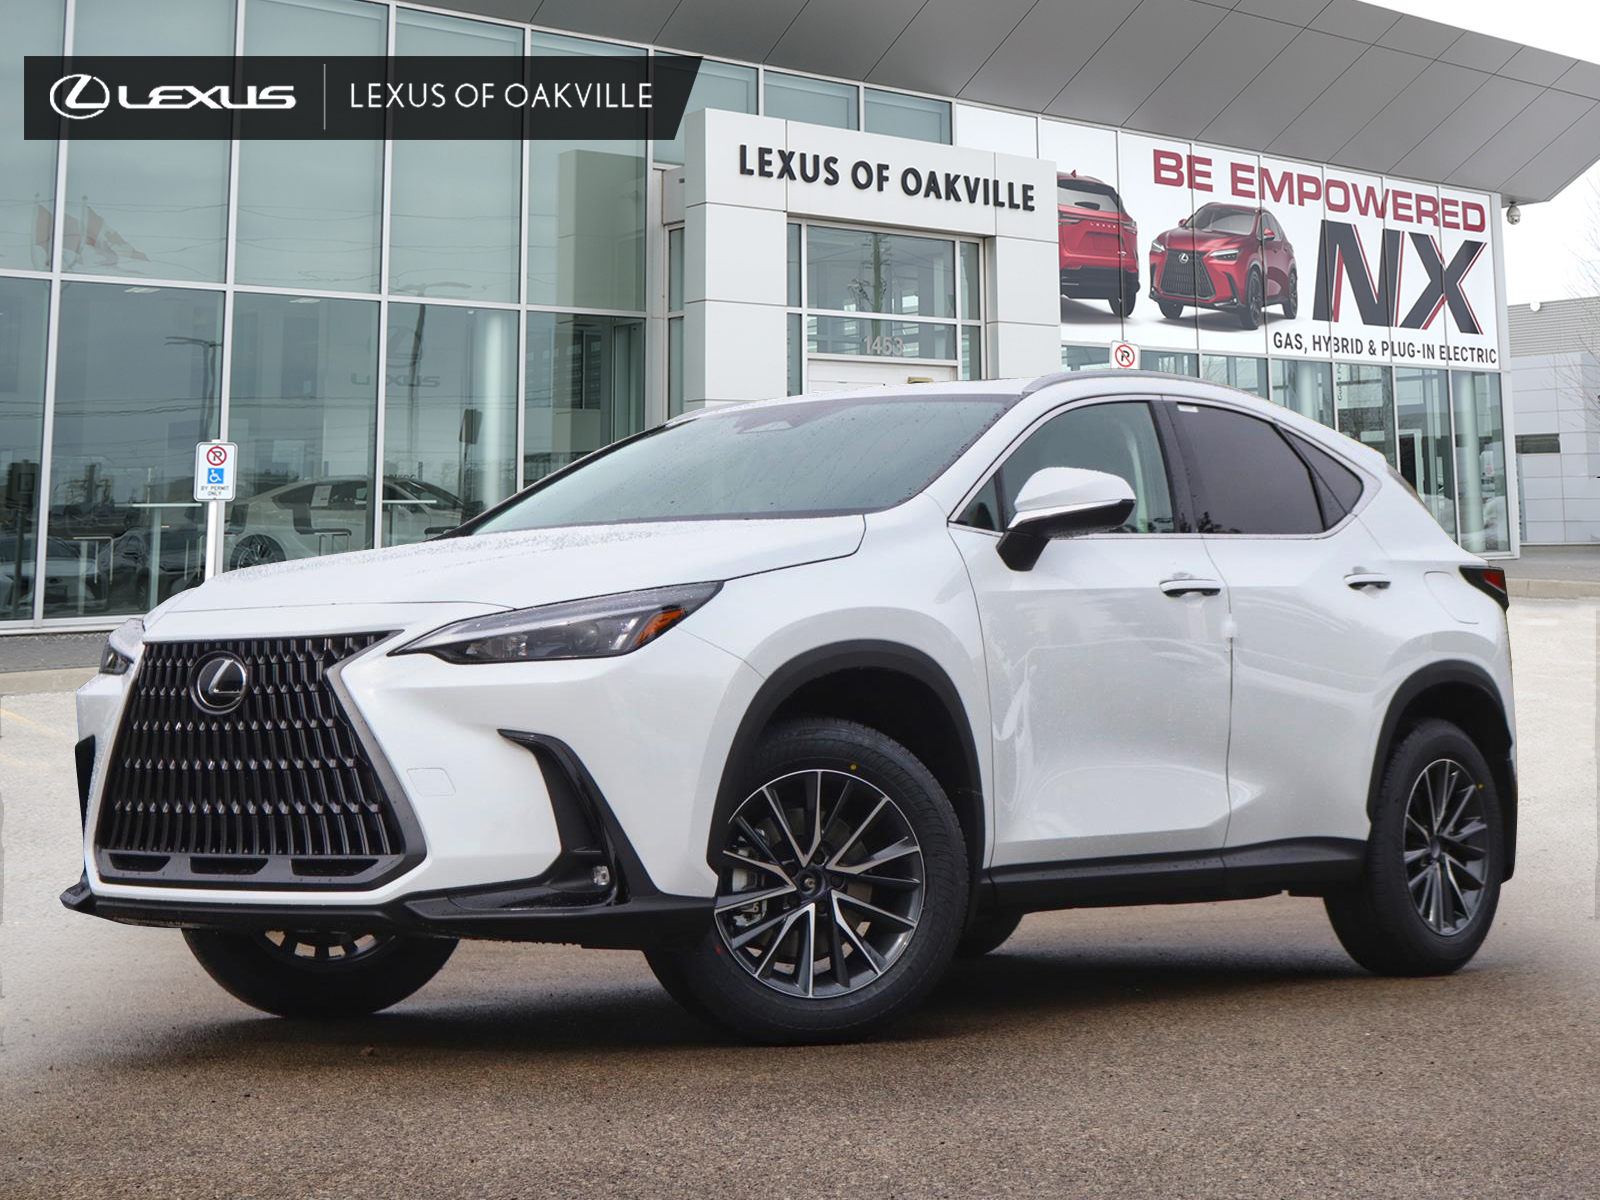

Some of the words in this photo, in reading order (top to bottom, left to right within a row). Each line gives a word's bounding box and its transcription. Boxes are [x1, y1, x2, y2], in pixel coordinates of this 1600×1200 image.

[739, 144, 840, 186] LEXUS
[851, 160, 890, 192] OF
[900, 166, 1036, 212] OAKVILLE
[1153, 149, 1214, 192] BE
[1230, 162, 1486, 233] EMPOWERED
[1312, 218, 1488, 335] NX
[862, 335, 904, 355] 1453
[1272, 331, 1308, 354] GAS,
[1312, 334, 1364, 355] HYBRID
[1368, 339, 1378, 356] &
[1381, 341, 1436, 360] PLUG-IN
[1439, 345, 1498, 364] ELECTRIC
[350, 373, 441, 388] LXUS
